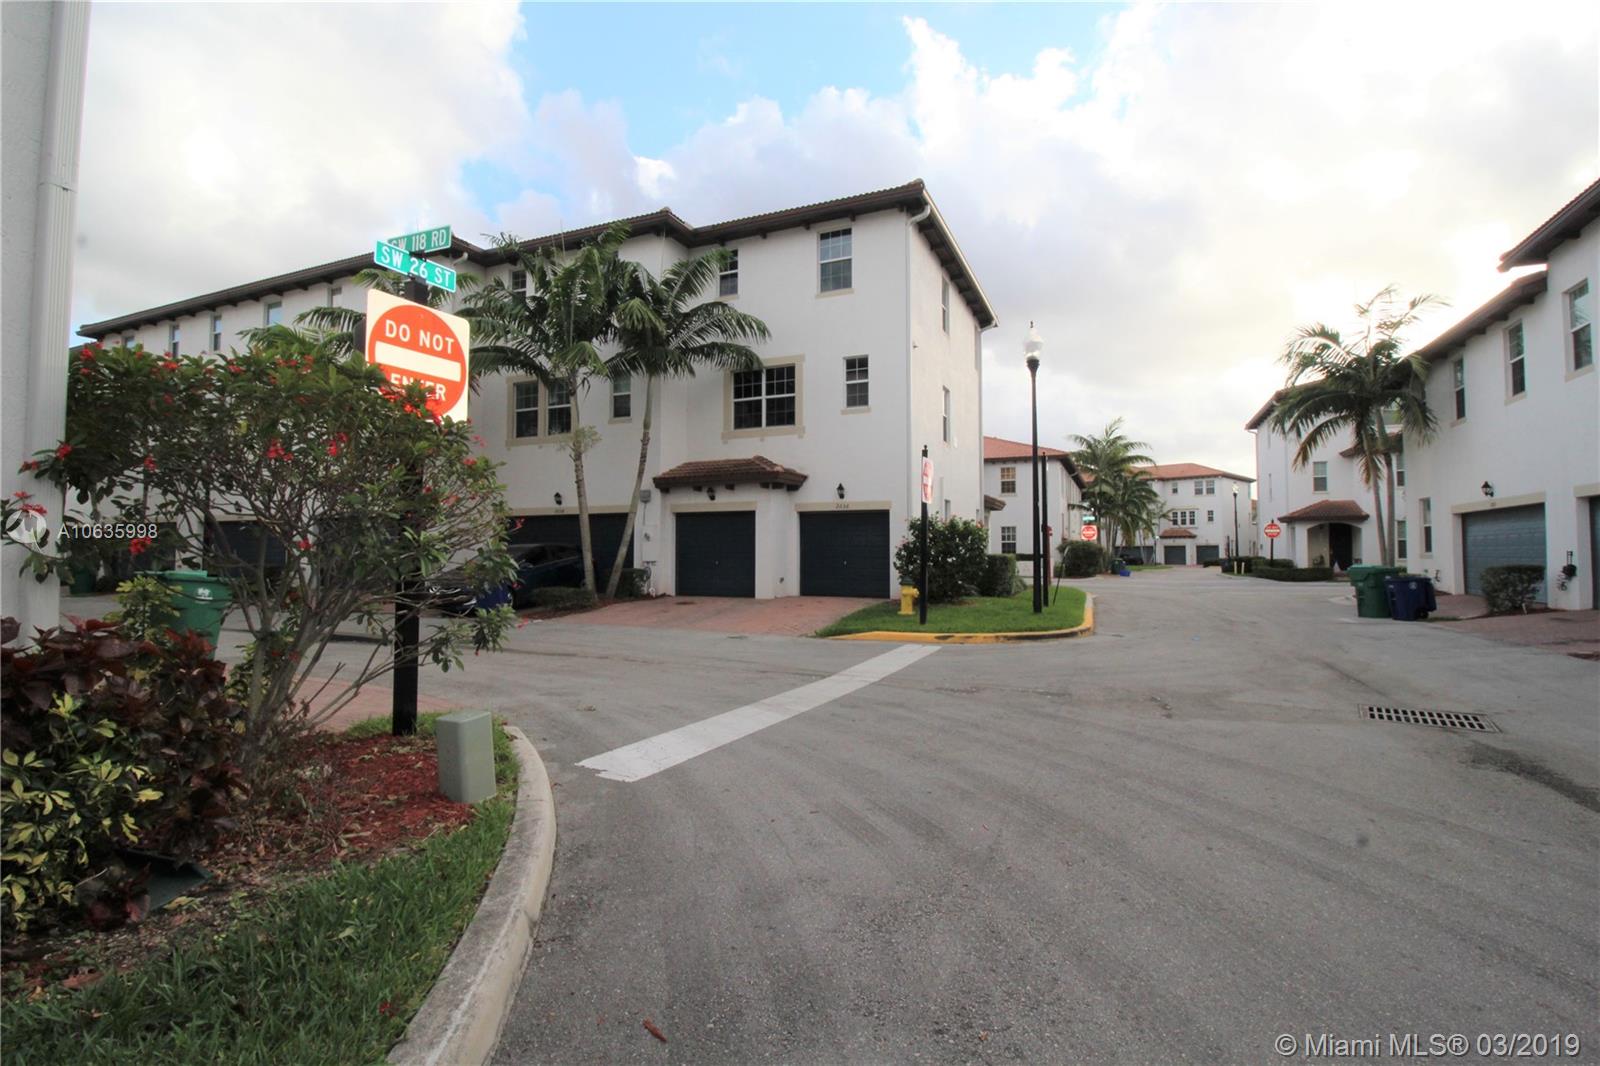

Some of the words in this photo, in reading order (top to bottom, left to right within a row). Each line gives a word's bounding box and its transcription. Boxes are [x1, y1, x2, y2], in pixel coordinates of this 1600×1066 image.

[411, 233, 427, 251] 118
[431, 229, 447, 247] RD
[381, 245, 403, 268] SW
[409, 258, 429, 279] 26
[433, 268, 451, 287] ST
[384, 319, 411, 342] DO
[418, 331, 455, 355] NOT
